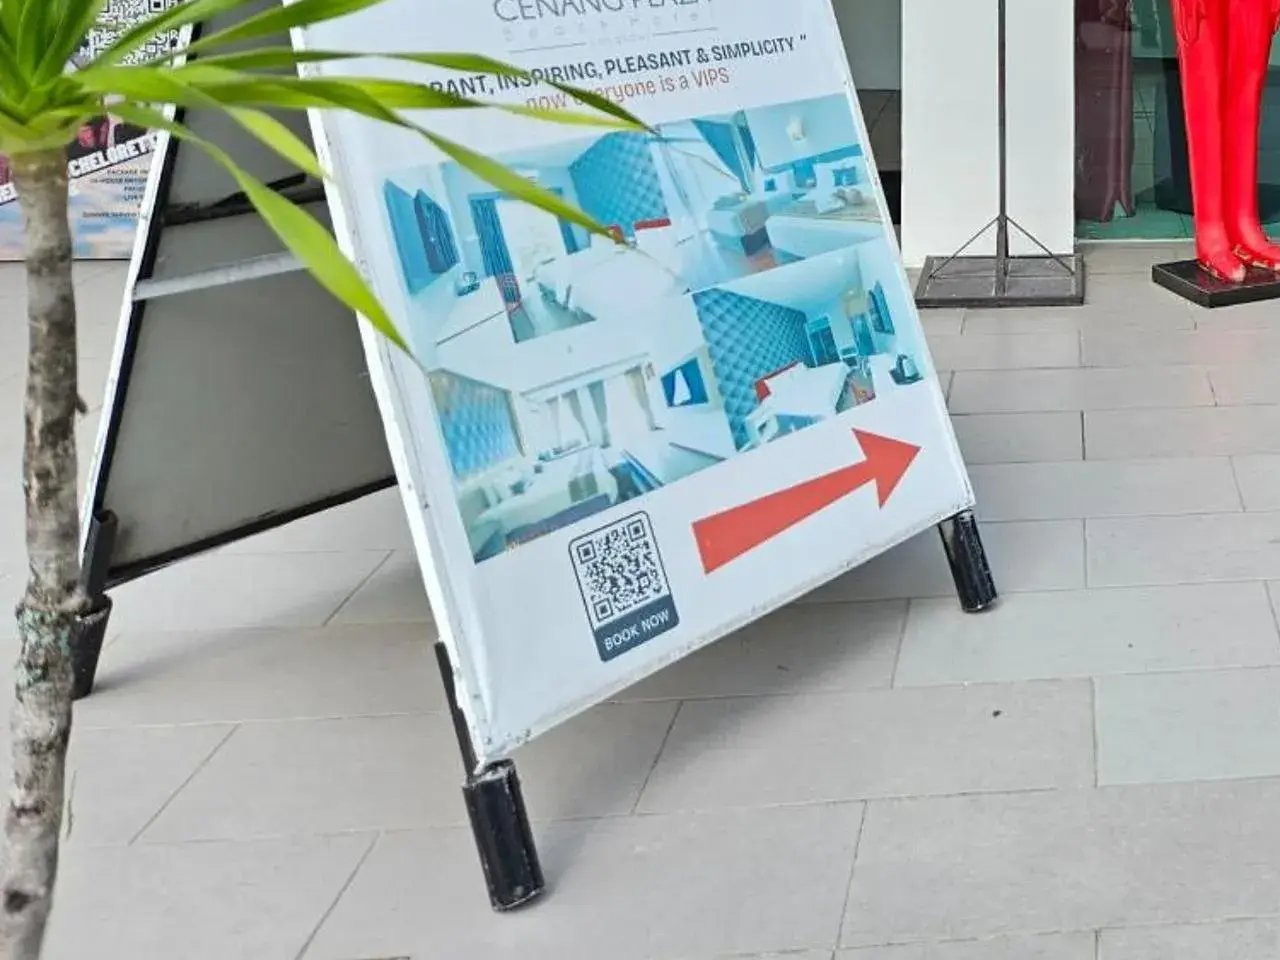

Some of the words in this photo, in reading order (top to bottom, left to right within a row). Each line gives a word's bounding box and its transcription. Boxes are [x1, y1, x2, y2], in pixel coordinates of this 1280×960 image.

[429, 75, 494, 98] RANT,
[496, 61, 604, 90] INSPIRING,
[605, 49, 691, 76] PLEASANT
[696, 47, 709, 64] &
[711, 37, 794, 62] SIMPLICITY
[574, 79, 656, 106] eeryone
[659, 74, 675, 92] is
[680, 75, 689, 89] a
[691, 67, 730, 88] VIPS
[604, 625, 640, 651] BOOK
[641, 609, 670, 632] NOW
